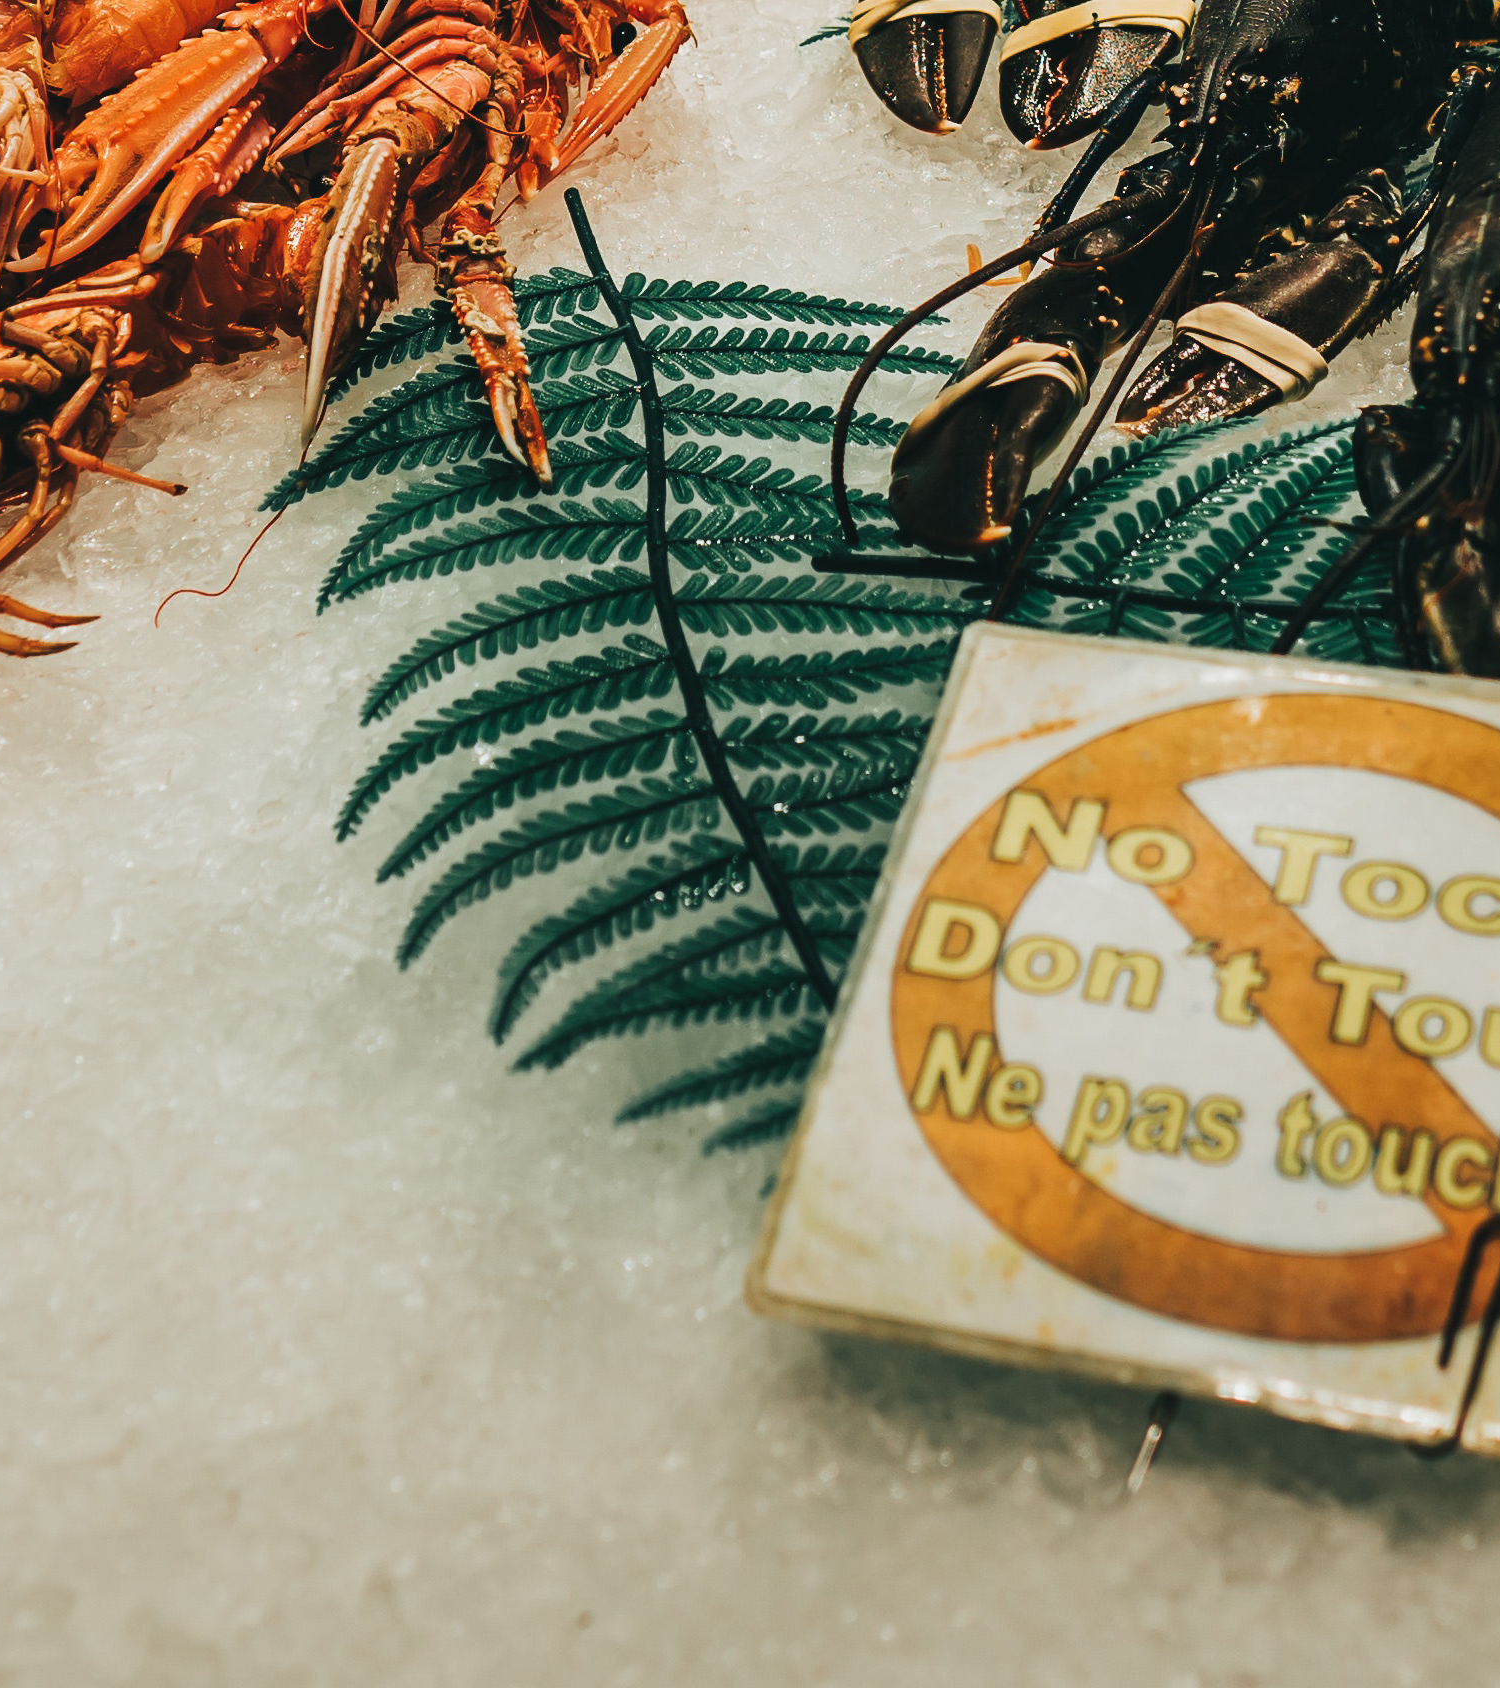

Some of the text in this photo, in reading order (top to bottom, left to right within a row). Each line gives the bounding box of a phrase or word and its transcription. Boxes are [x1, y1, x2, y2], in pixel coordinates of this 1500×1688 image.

[990, 787, 1195, 885] No
[910, 1022, 1046, 1132] Ne
[1058, 1074, 1245, 1172] pas
